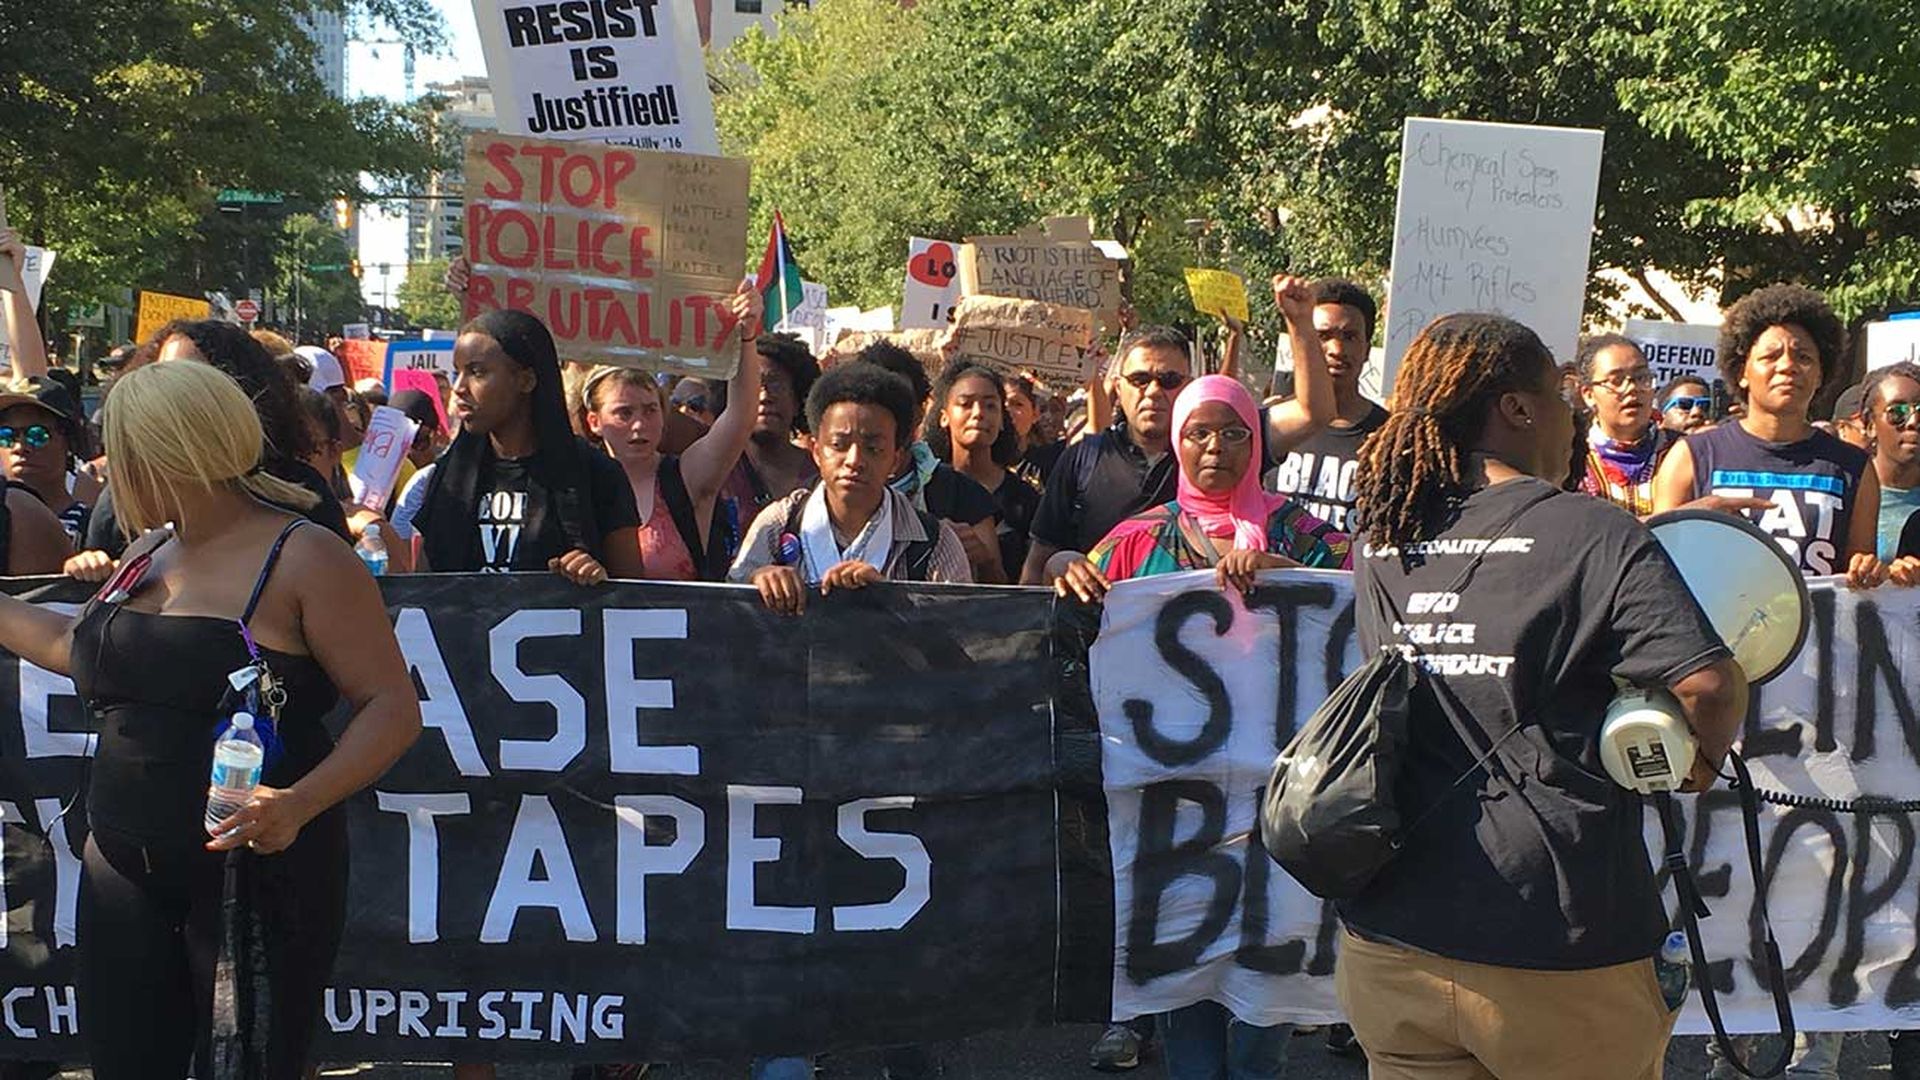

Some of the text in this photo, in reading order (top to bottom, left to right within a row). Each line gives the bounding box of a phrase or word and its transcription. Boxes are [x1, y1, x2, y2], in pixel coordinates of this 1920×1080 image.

[504, 0, 659, 47] RESIST
[570, 45, 619, 81] IS
[528, 84, 680, 133] Justified!
[484, 143, 636, 209] STOP
[1418, 132, 1507, 184] Chemical
[468, 203, 654, 279] POLICE
[976, 246, 1101, 266] A RIOT IS THE
[1416, 215, 1510, 260] Humvees
[978, 267, 1115, 292] LANGUAGE OF
[1466, 260, 1537, 307] Rifles
[466, 275, 739, 351] BRUTALITY
[407, 353, 440, 370] JAIL
[1644, 343, 1715, 367] DEFEND
[1277, 451, 1360, 503] BLAC
[1711, 488, 1843, 540] AT
[1406, 591, 1461, 614] END
[375, 784, 932, 945] TAPES
[1126, 779, 1339, 987] BL
[323, 987, 625, 1043] UPRISING
